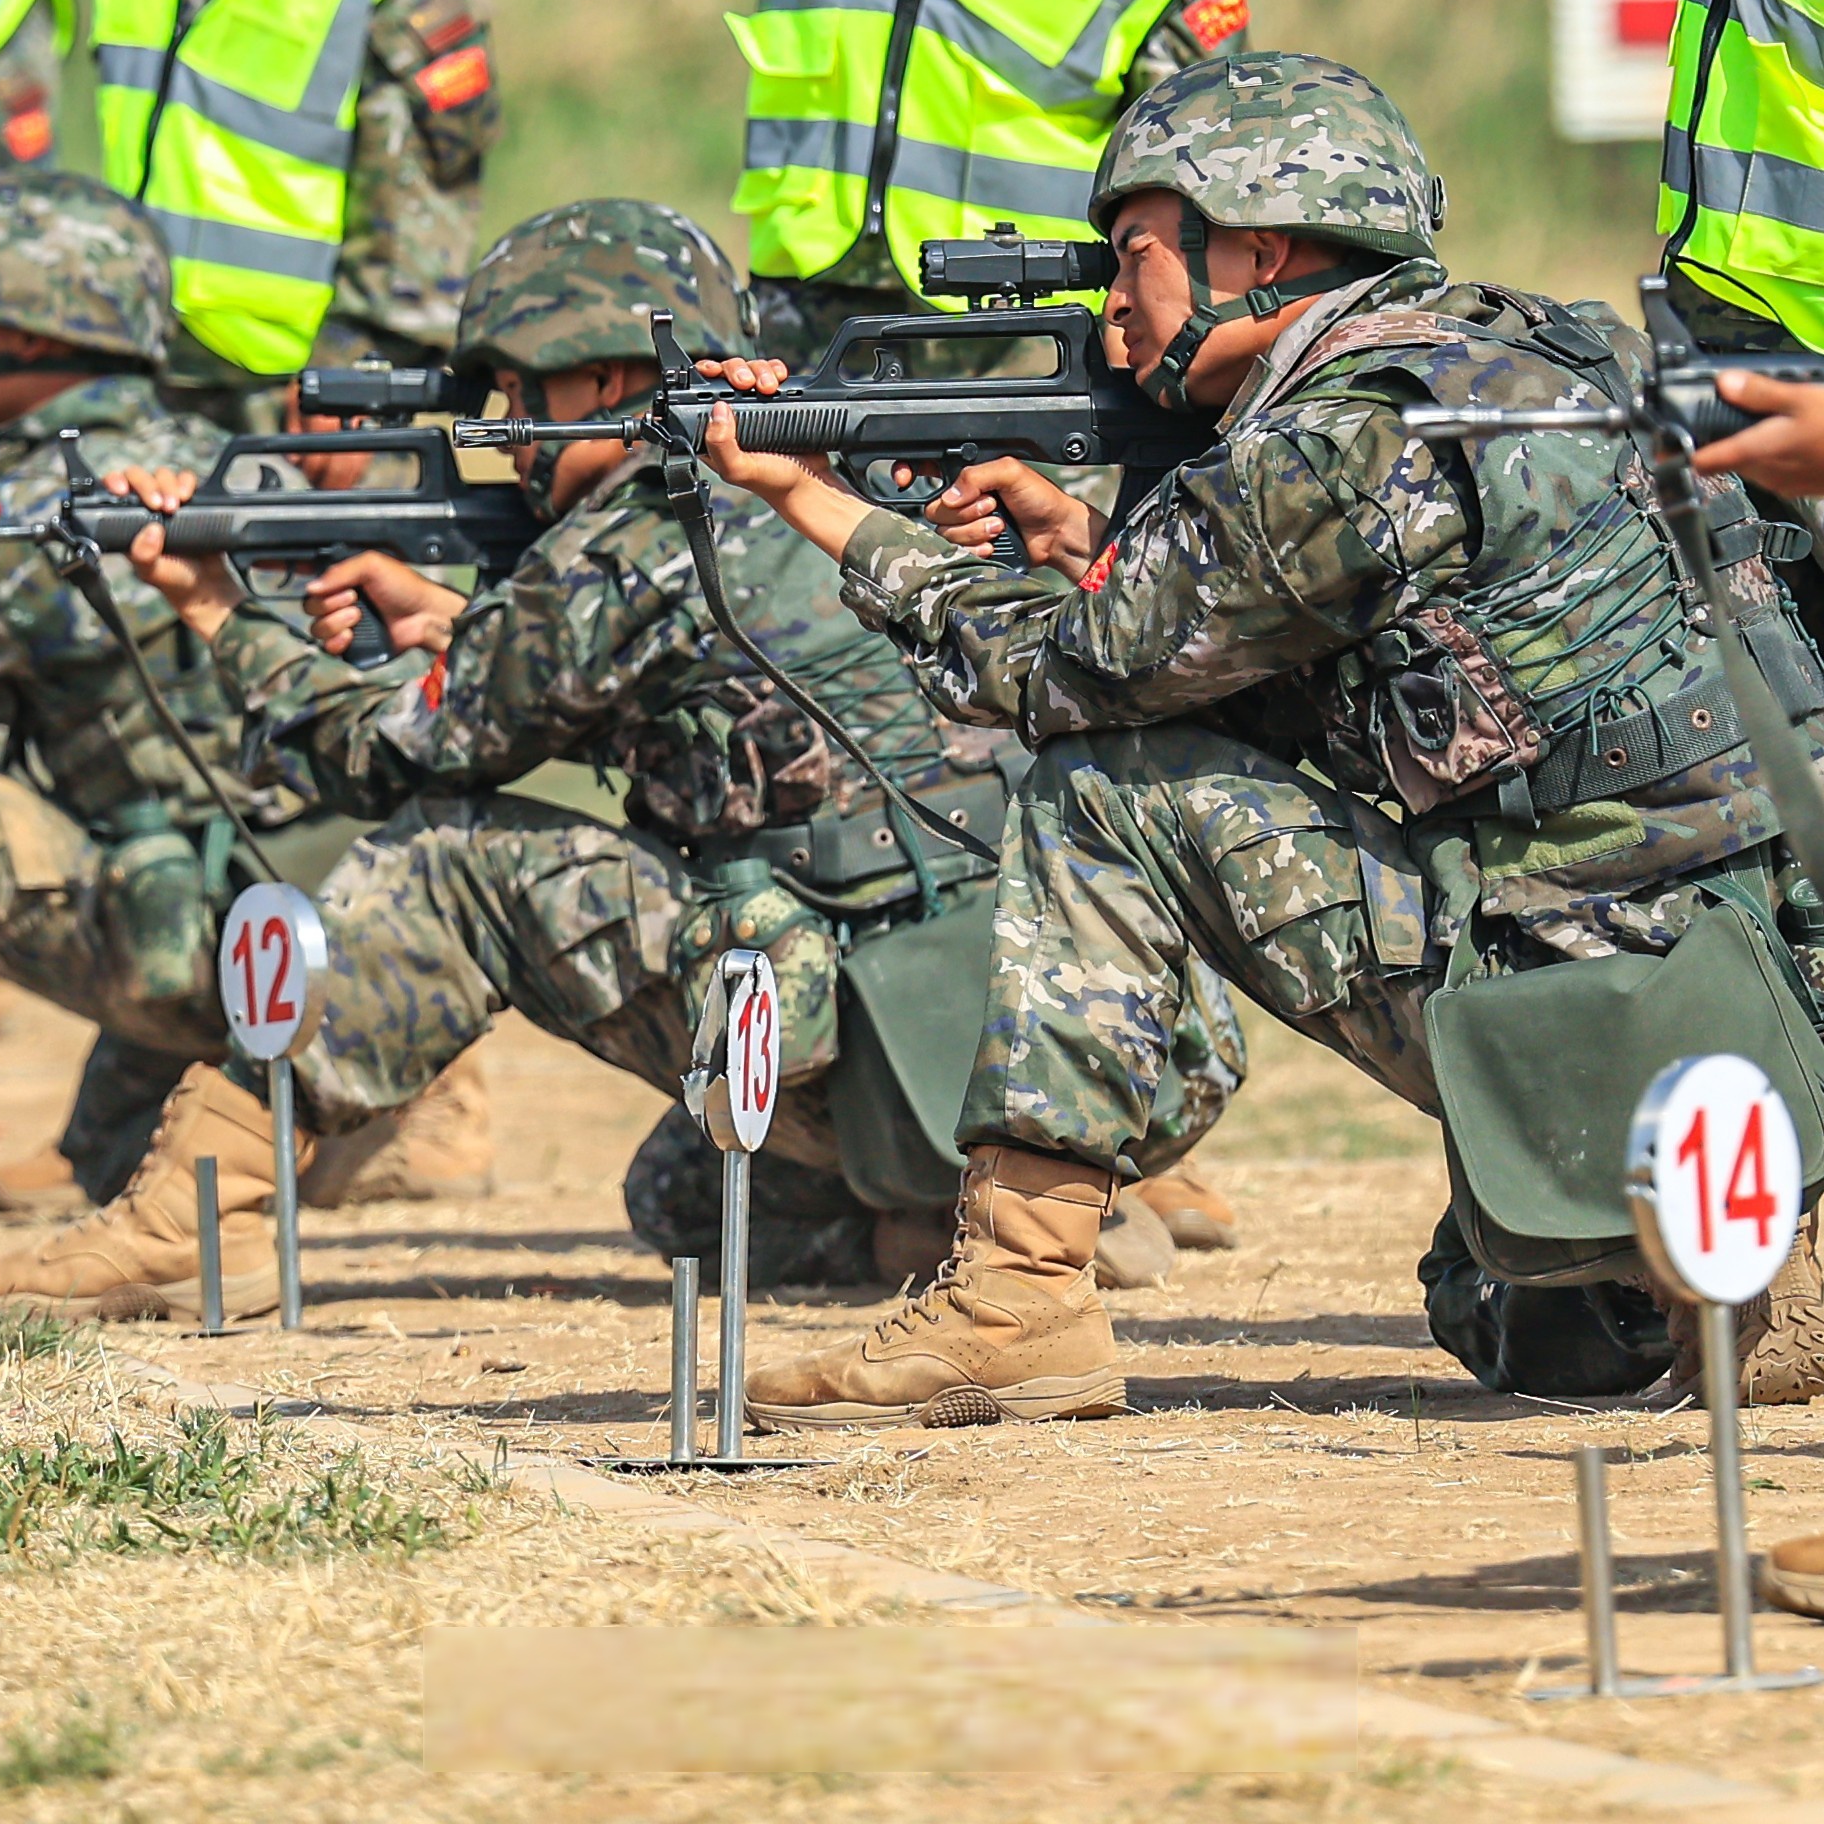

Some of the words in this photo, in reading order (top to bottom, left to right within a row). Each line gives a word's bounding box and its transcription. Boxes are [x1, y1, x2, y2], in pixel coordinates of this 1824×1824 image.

[232, 915, 296, 1027] 12
[737, 990, 772, 1114] 13
[1677, 1101, 1778, 1253] 14
